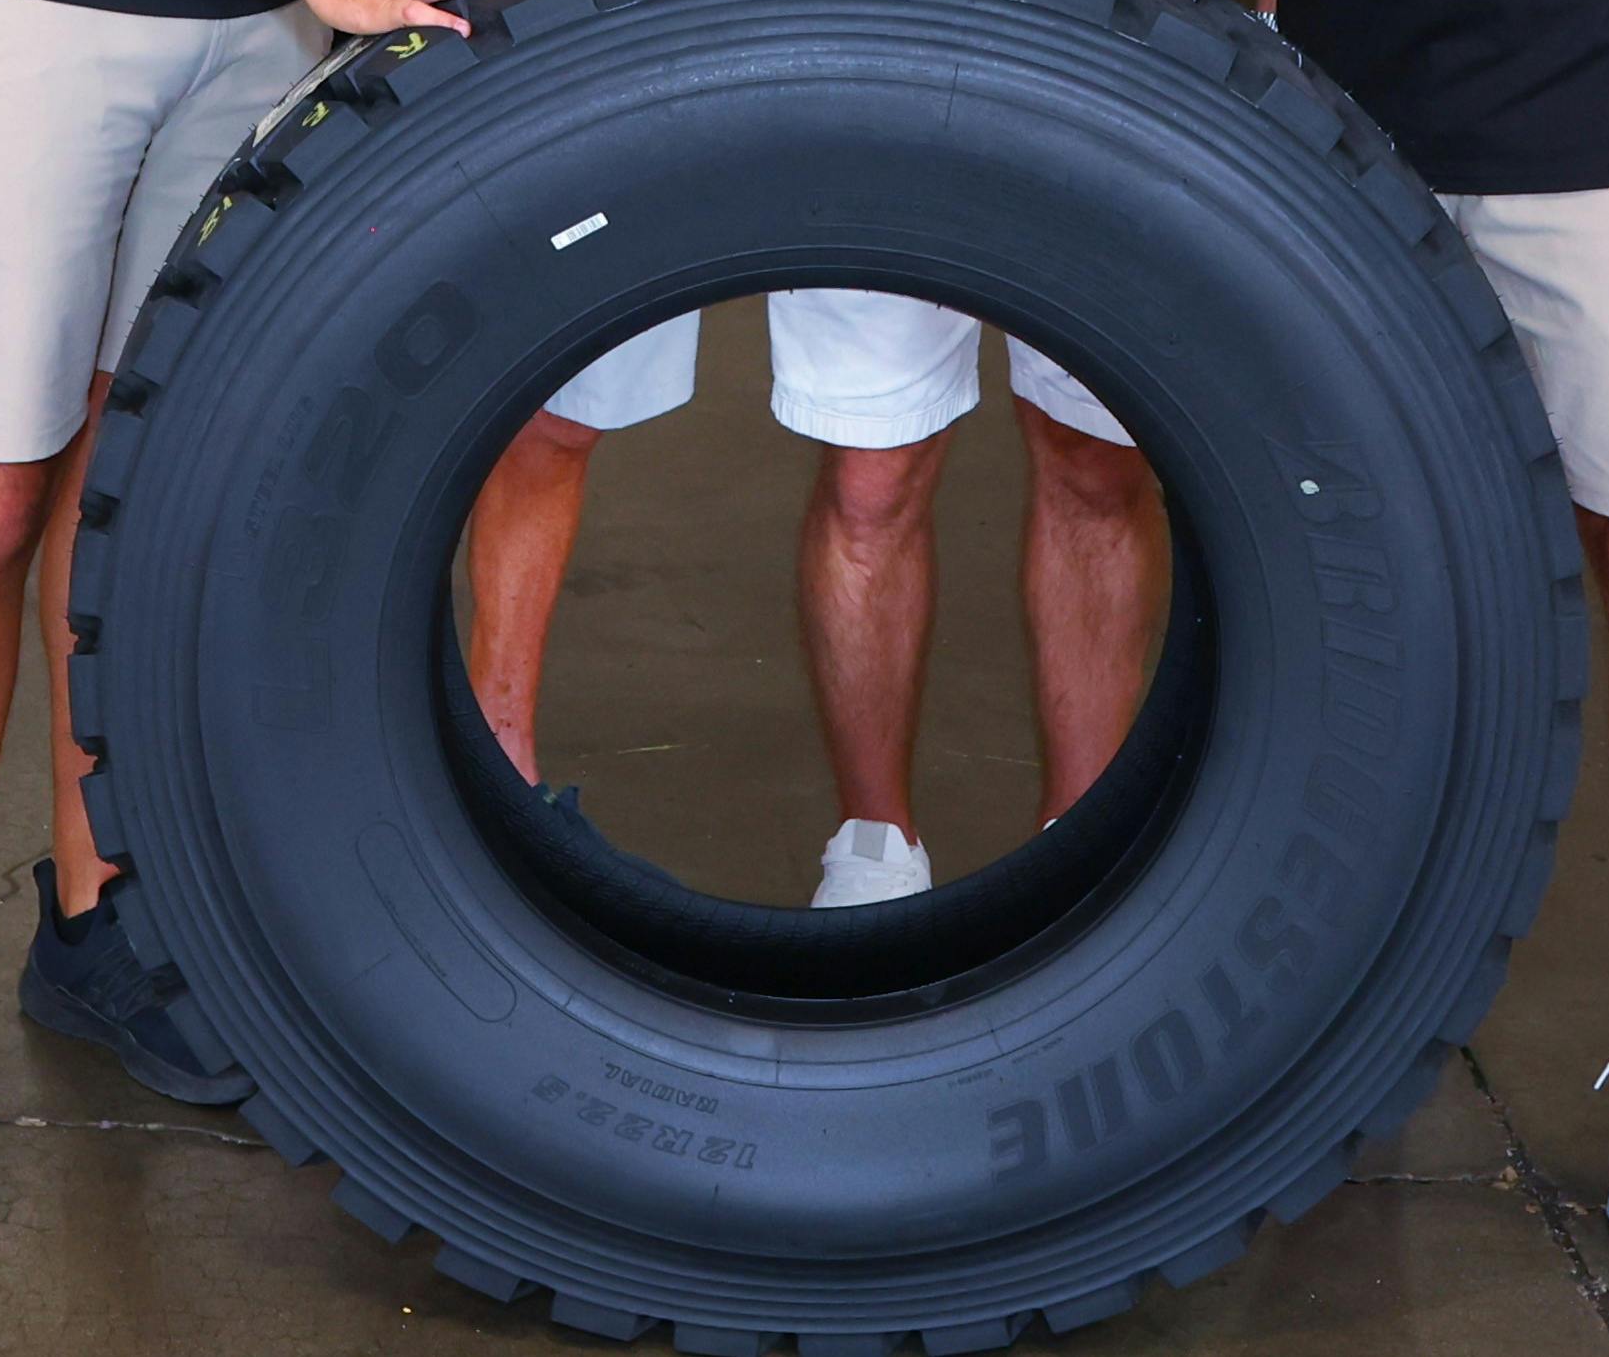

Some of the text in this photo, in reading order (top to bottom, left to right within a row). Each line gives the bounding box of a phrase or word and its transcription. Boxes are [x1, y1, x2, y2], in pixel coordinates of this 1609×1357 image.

[987, 431, 1410, 1184] BRIDGESTONE
[530, 1074, 759, 1170] 12R22.5
[603, 1061, 718, 1113] RADIAL
